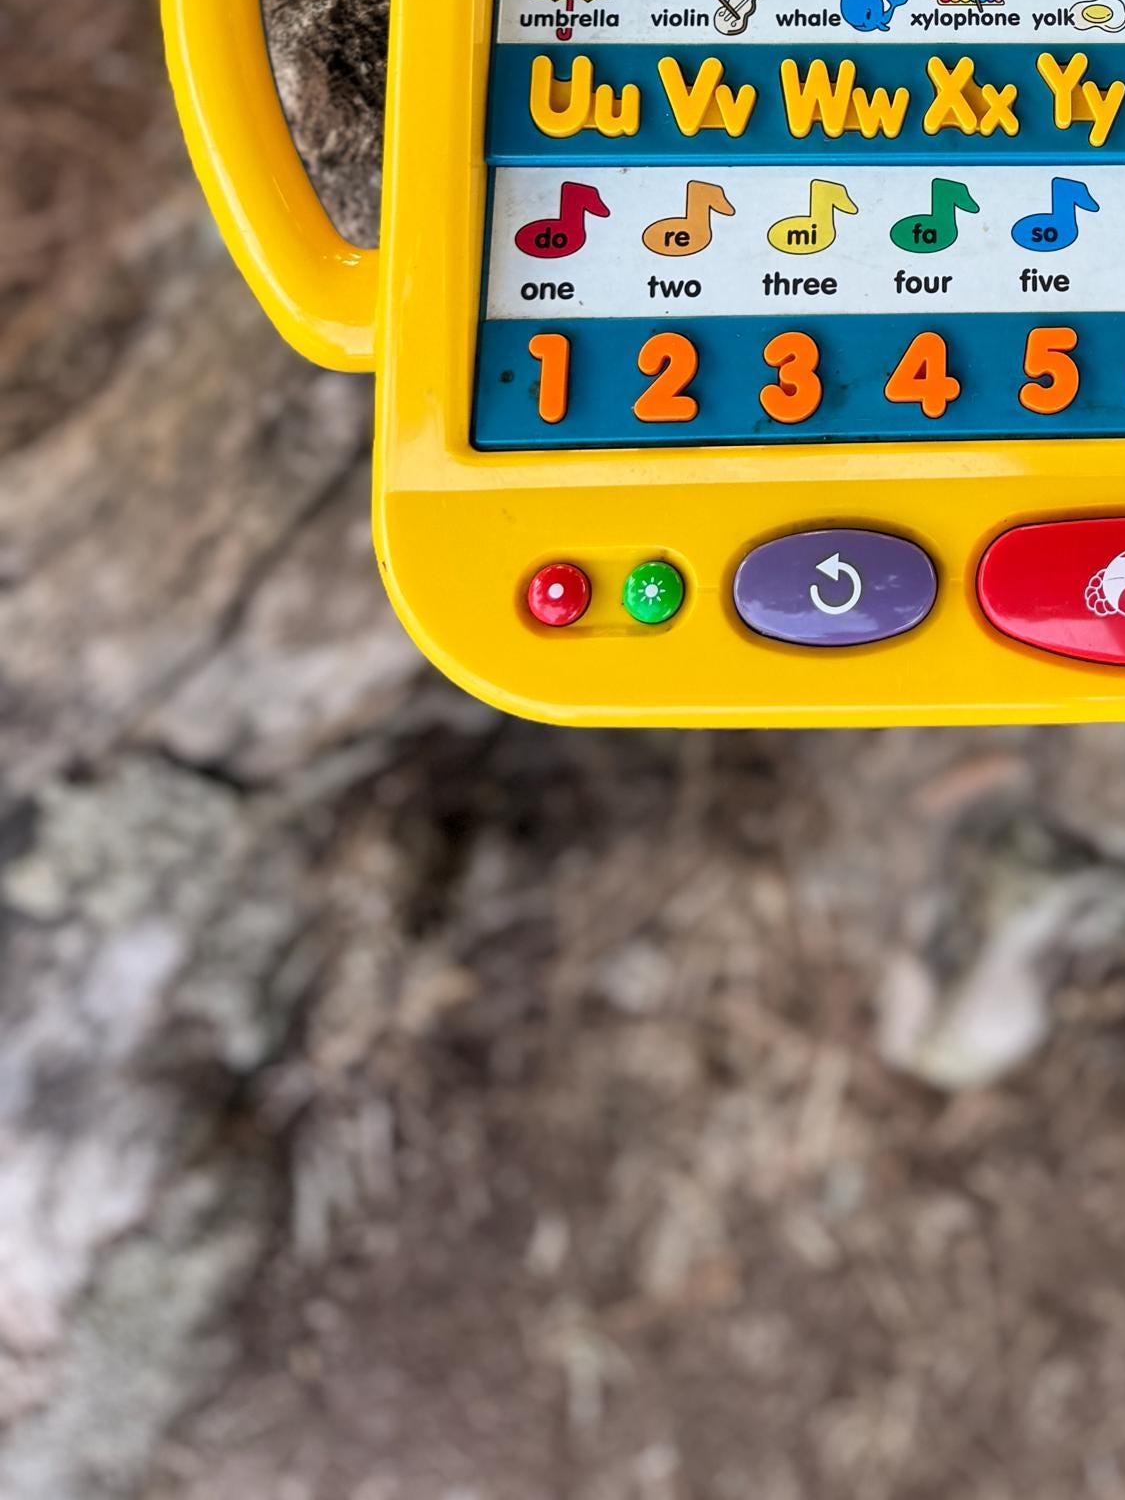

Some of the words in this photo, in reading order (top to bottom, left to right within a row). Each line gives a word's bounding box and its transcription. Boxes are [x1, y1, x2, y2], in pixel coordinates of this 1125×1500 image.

[520, 9, 619, 27] umbrella
[651, 10, 709, 27] violin
[776, 10, 841, 27] whale
[910, 9, 1020, 29] xylophone
[1032, 9, 1075, 29] yolk
[530, 55, 640, 138] Uu
[657, 56, 758, 138] Vv
[781, 58, 909, 139] Ww
[922, 56, 1019, 136] Xx
[1037, 52, 1125, 148] Yy
[534, 228, 567, 249] do
[664, 228, 690, 247] re
[787, 224, 817, 245] mi
[912, 223, 937, 244] fa
[1031, 225, 1058, 242] so
[521, 281, 575, 300] one
[648, 276, 702, 298] two
[763, 272, 837, 295] three
[894, 270, 952, 293] four
[1020, 268, 1070, 292] five
[528, 333, 570, 424] 1
[634, 332, 699, 423] 2
[759, 331, 823, 424] 3
[884, 331, 961, 419] 4
[1018, 327, 1079, 415] 5
